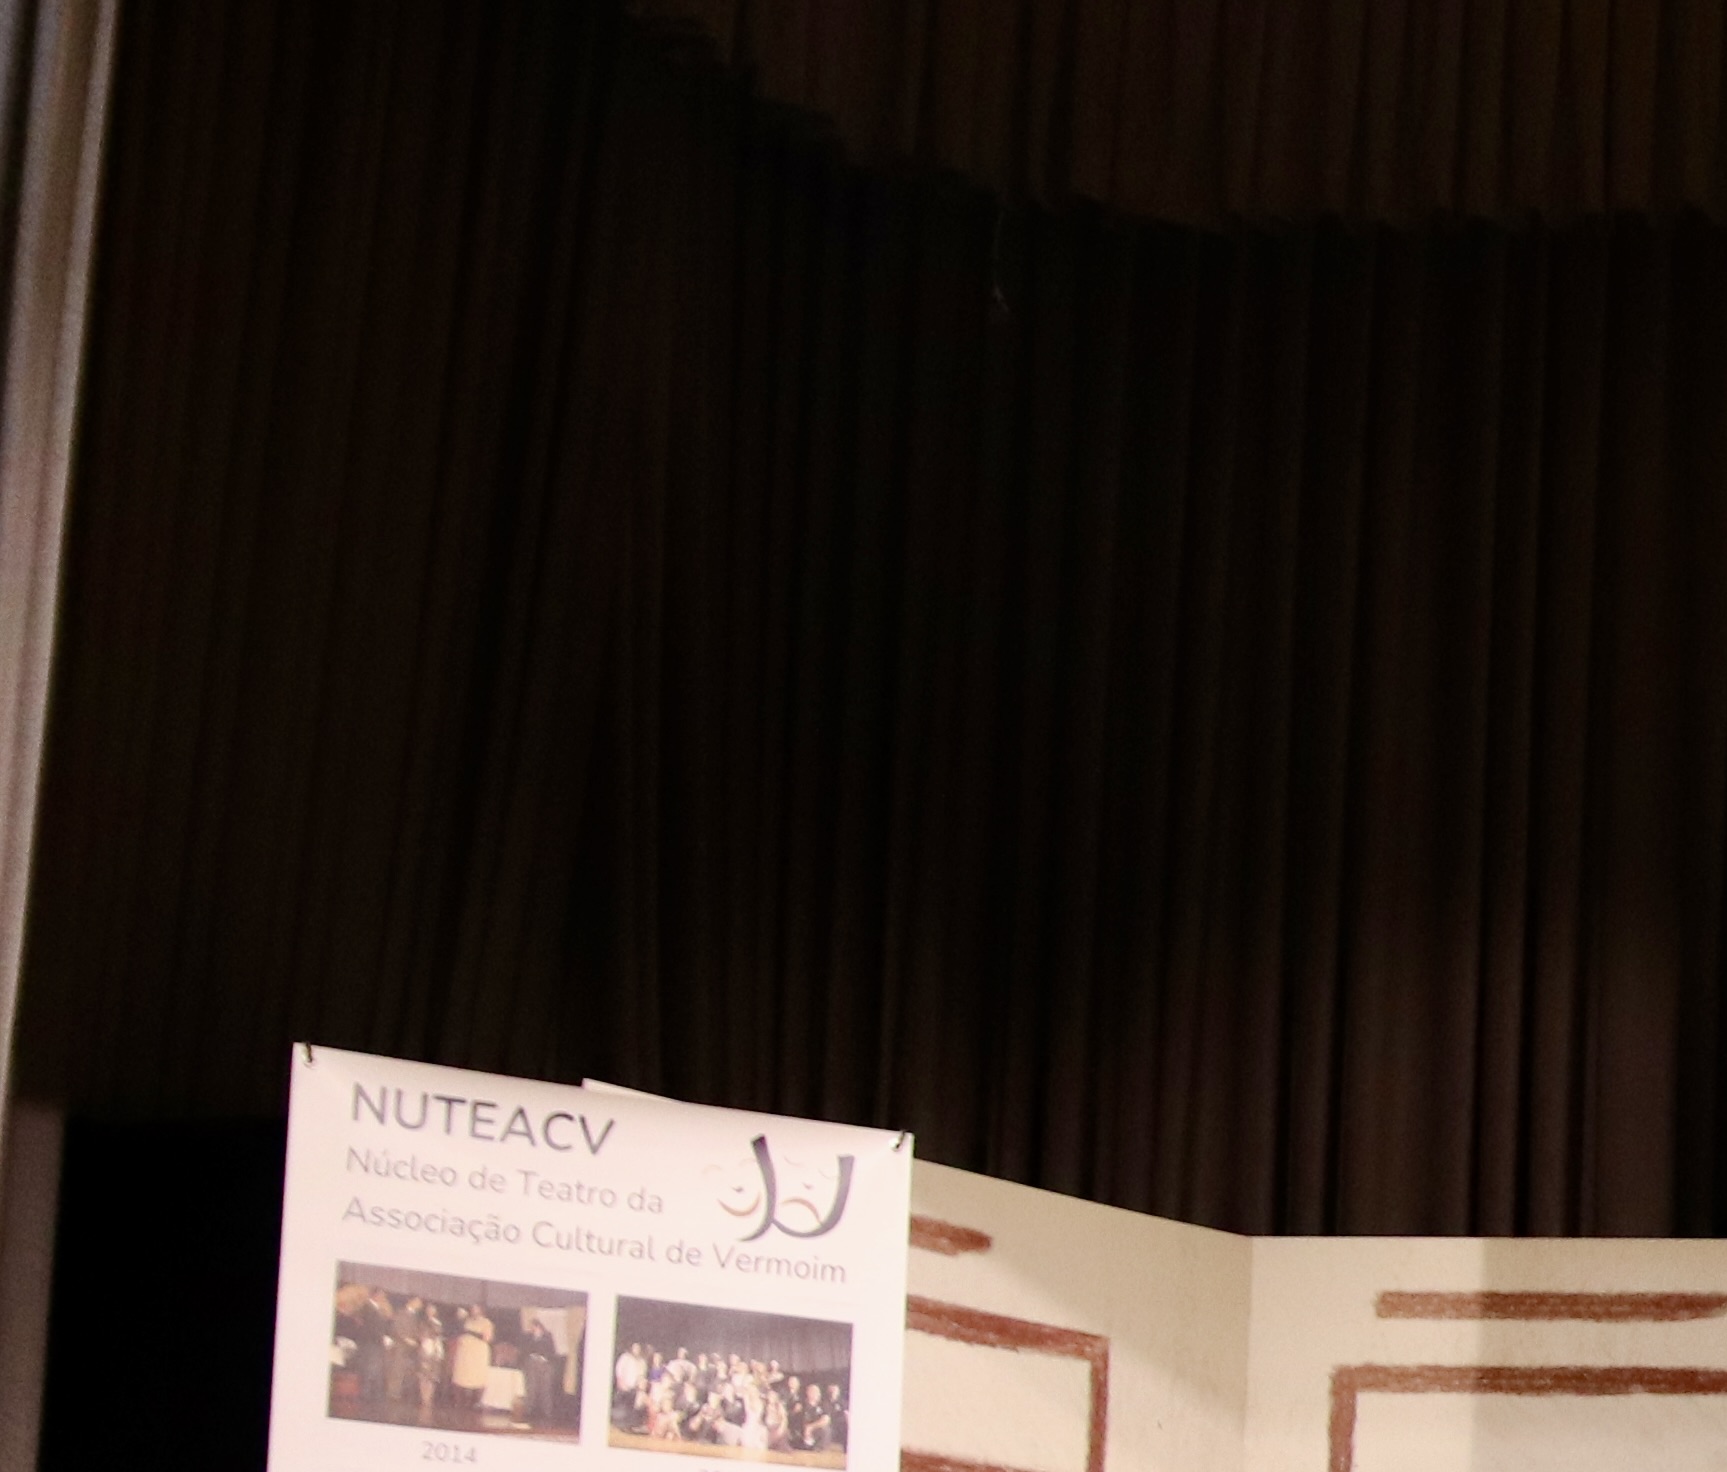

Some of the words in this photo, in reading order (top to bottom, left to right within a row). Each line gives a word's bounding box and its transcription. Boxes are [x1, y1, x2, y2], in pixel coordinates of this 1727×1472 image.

[352, 1081, 615, 1155] NUTEACV
[346, 1146, 457, 1187] Núcleo
[468, 1165, 506, 1193] de
[517, 1170, 617, 1208] Teatro
[627, 1187, 664, 1214] da
[342, 1196, 520, 1244] Associação
[531, 1221, 655, 1261] Cultural
[665, 1240, 702, 1266] de
[712, 1242, 847, 1283] Vermoim
[421, 1441, 478, 1465] 2014
